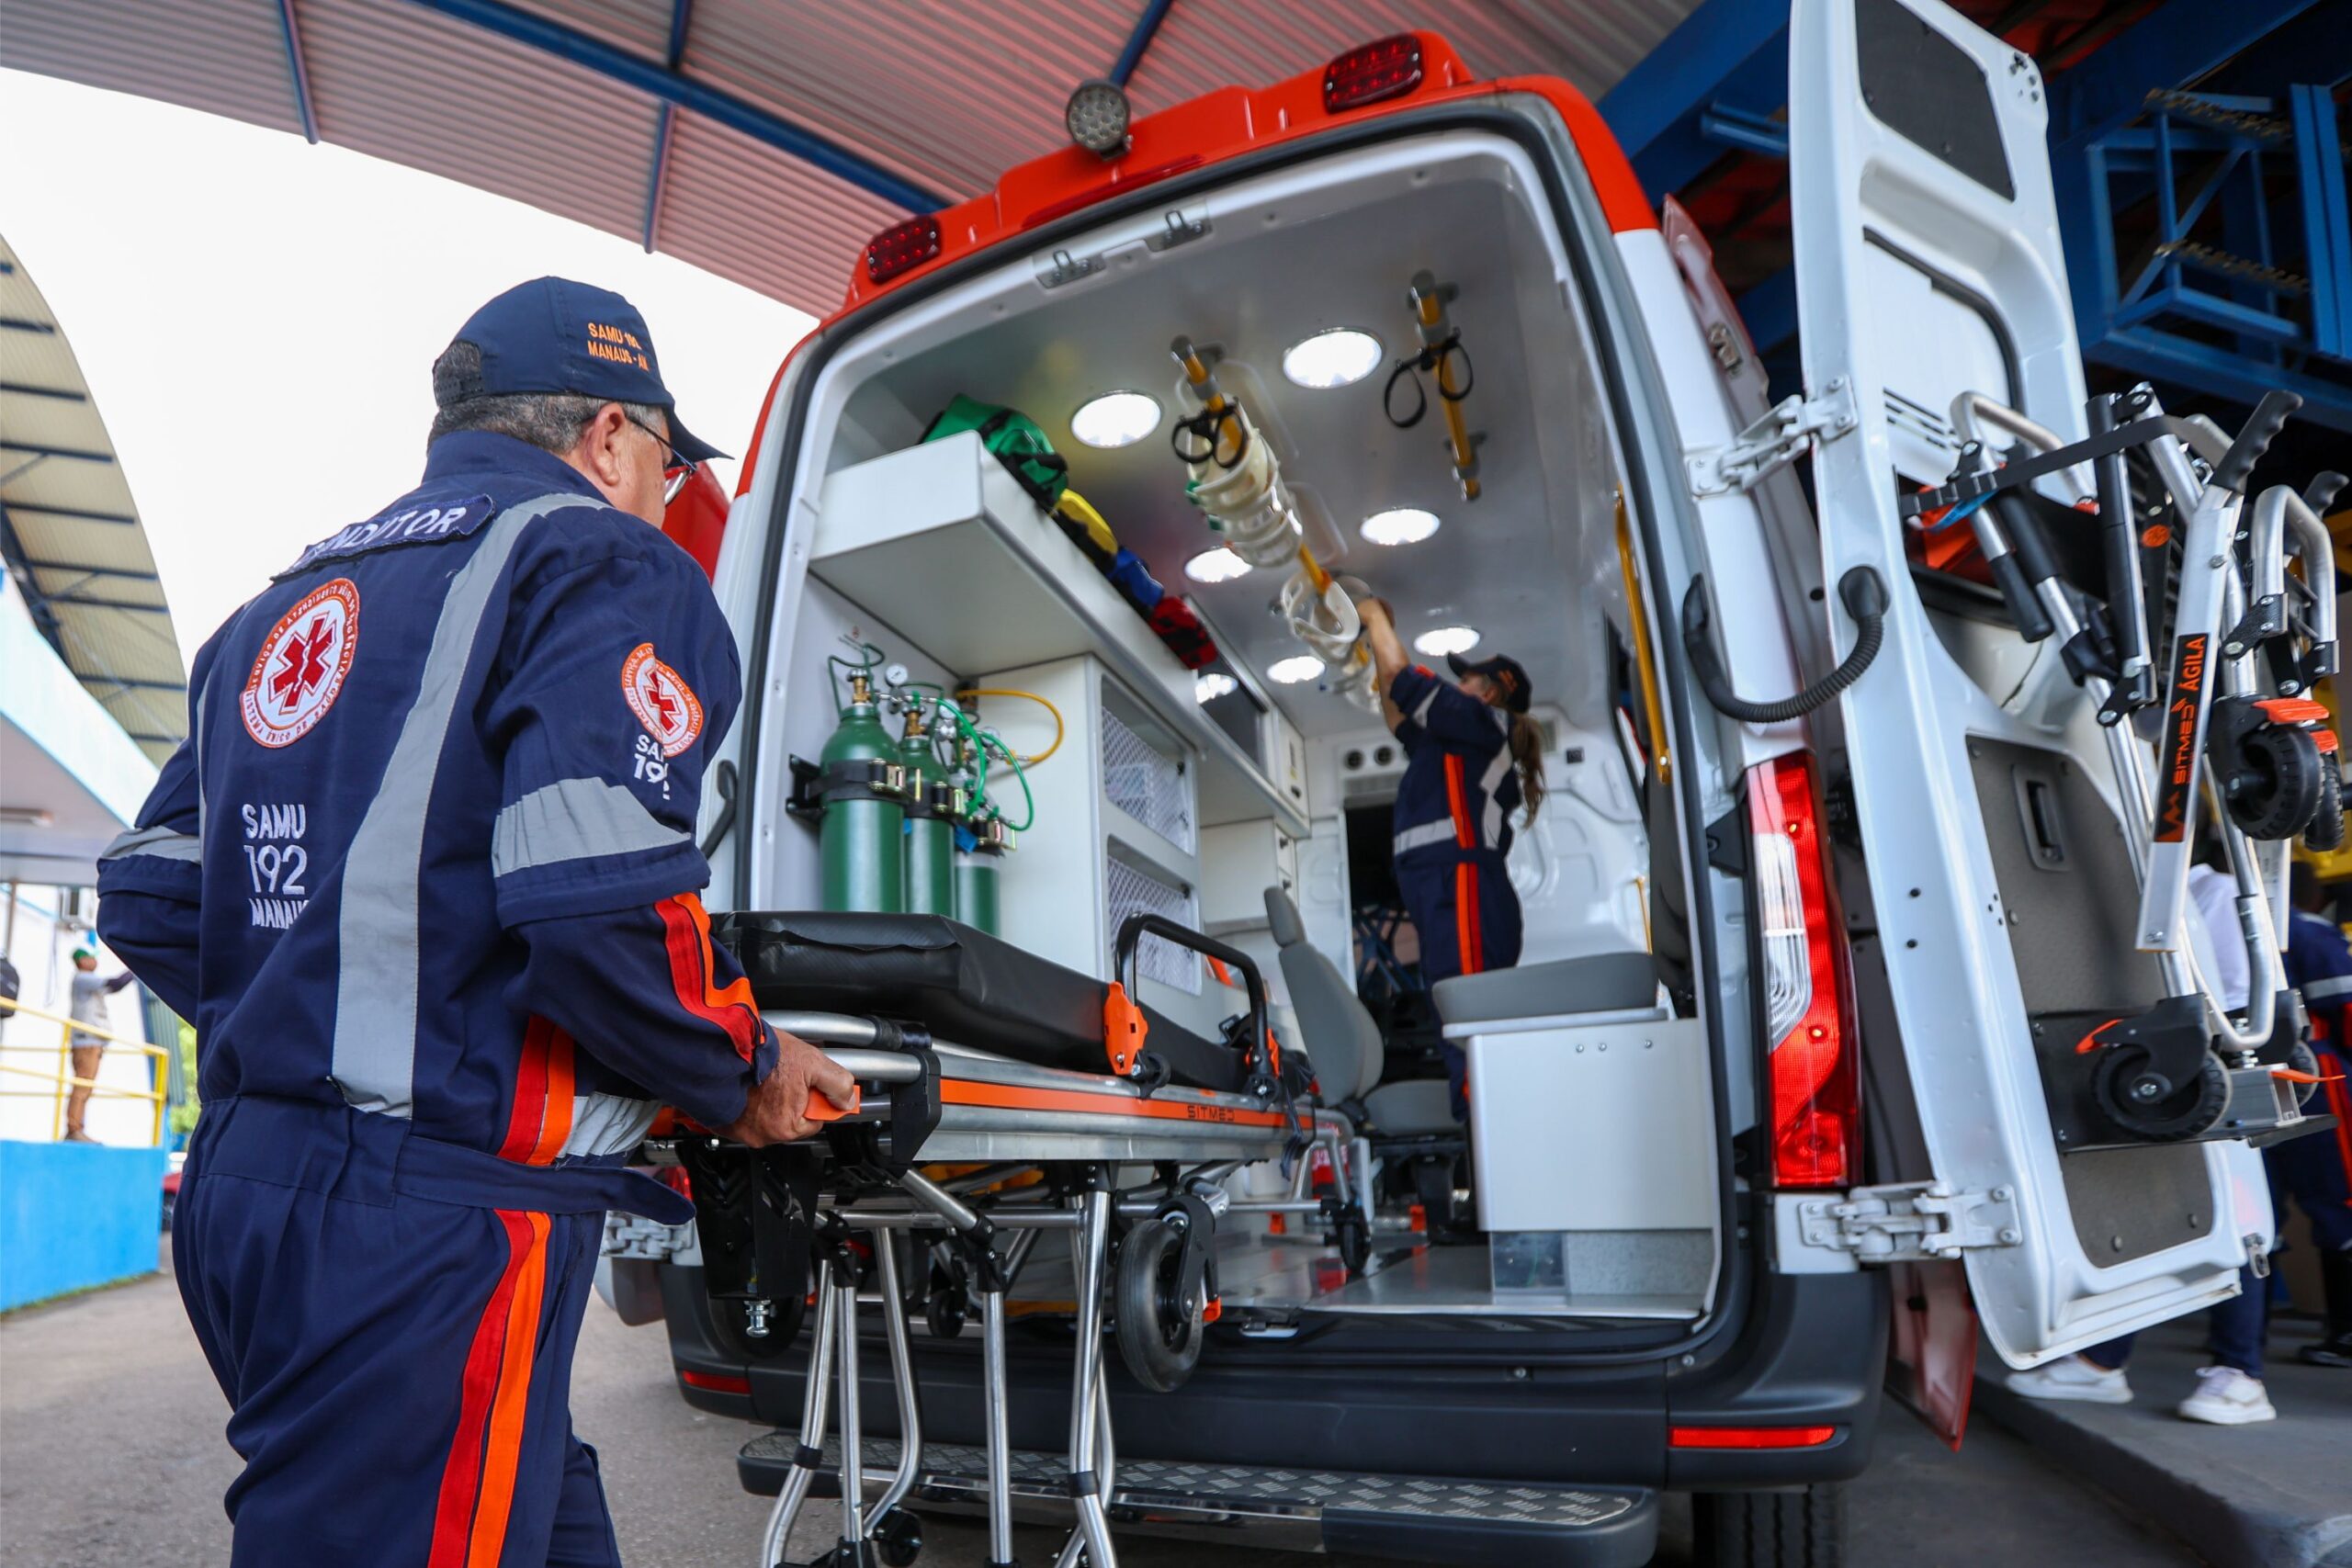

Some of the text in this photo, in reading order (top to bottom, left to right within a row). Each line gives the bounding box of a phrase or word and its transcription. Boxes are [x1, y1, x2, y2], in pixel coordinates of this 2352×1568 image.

[588, 322, 624, 344] SAMU
[588, 340, 633, 365] MANAUS
[2173, 636, 2206, 785] SITMED ÁGILA
[242, 804, 306, 840] SAMU
[243, 844, 307, 895] 192
[248, 898, 310, 930] MANAU
[1187, 1105, 1235, 1122] SITMED
